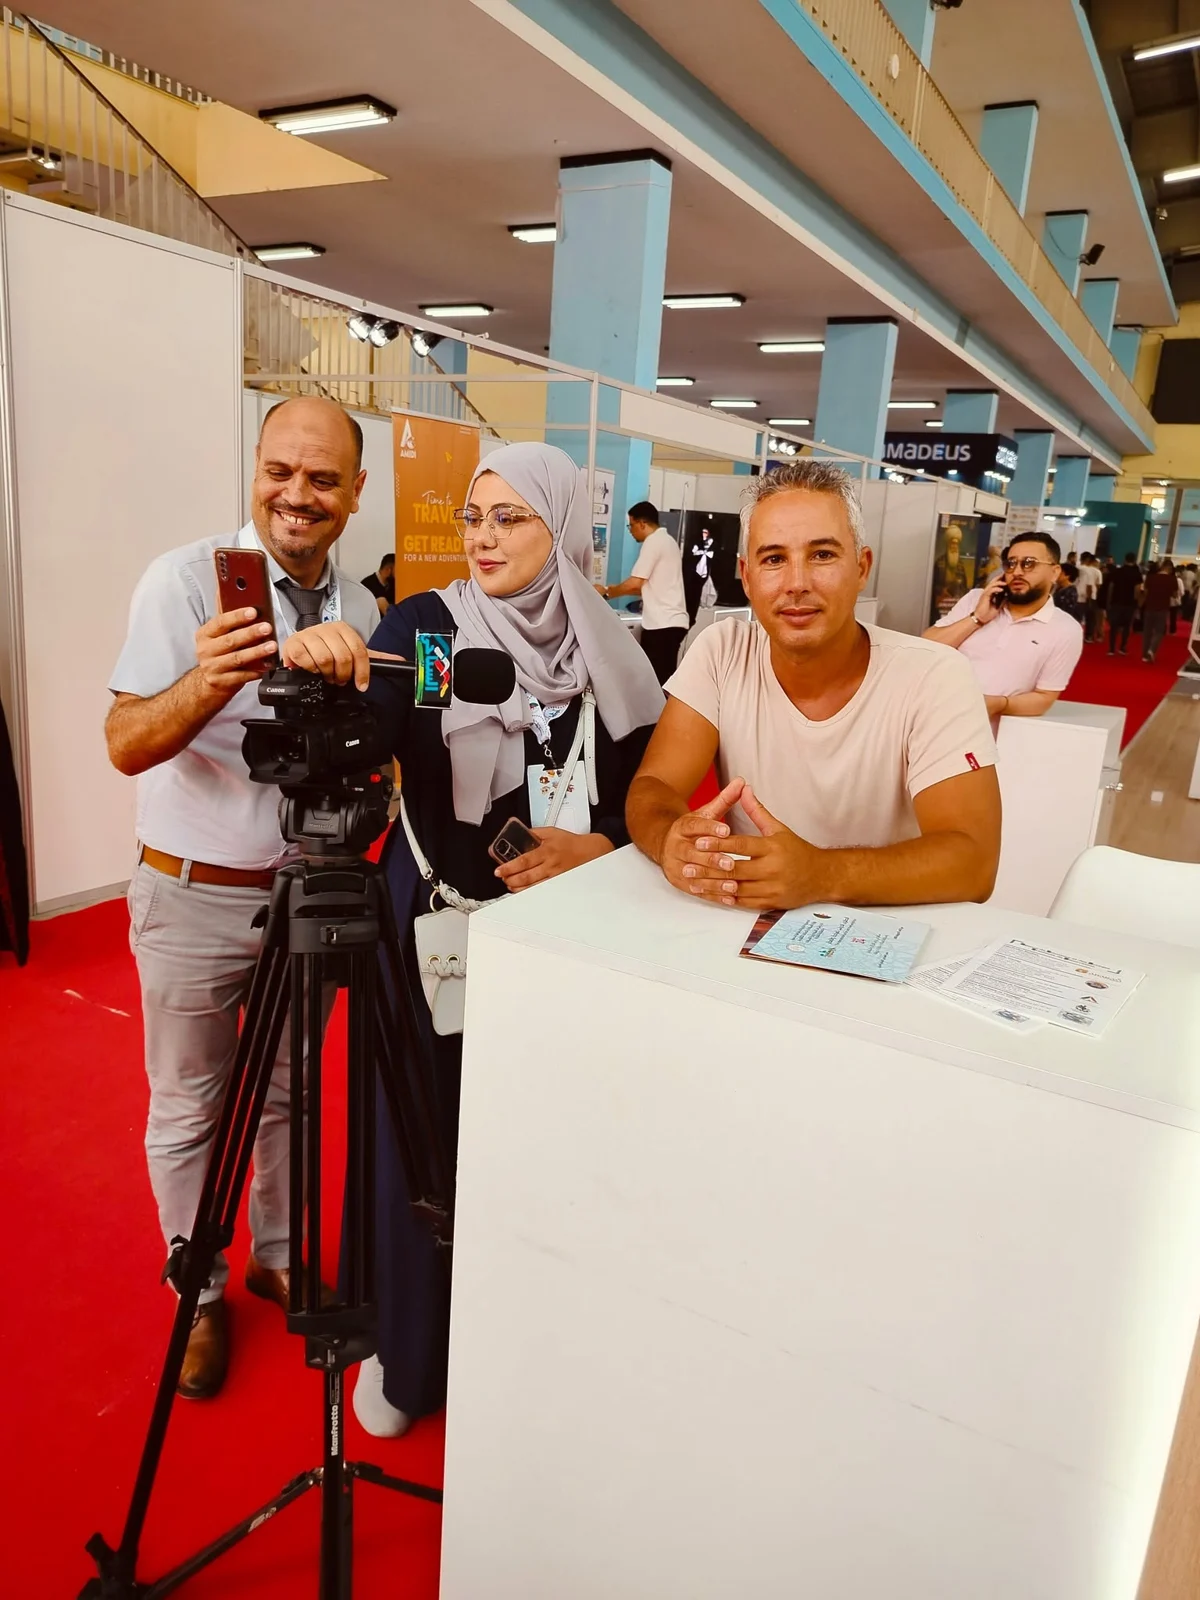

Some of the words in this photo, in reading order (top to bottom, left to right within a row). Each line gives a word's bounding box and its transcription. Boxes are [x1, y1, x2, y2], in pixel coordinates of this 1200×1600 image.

[883, 443, 971, 461] MaDEUS
[422, 490, 445, 507] Time
[413, 503, 461, 525] TRAVE
[403, 535, 429, 552] GET
[431, 536, 463, 553] READ
[404, 553, 417, 562] FOR
[424, 554, 437, 562] NEW
[345, 739, 360, 747] Canon
